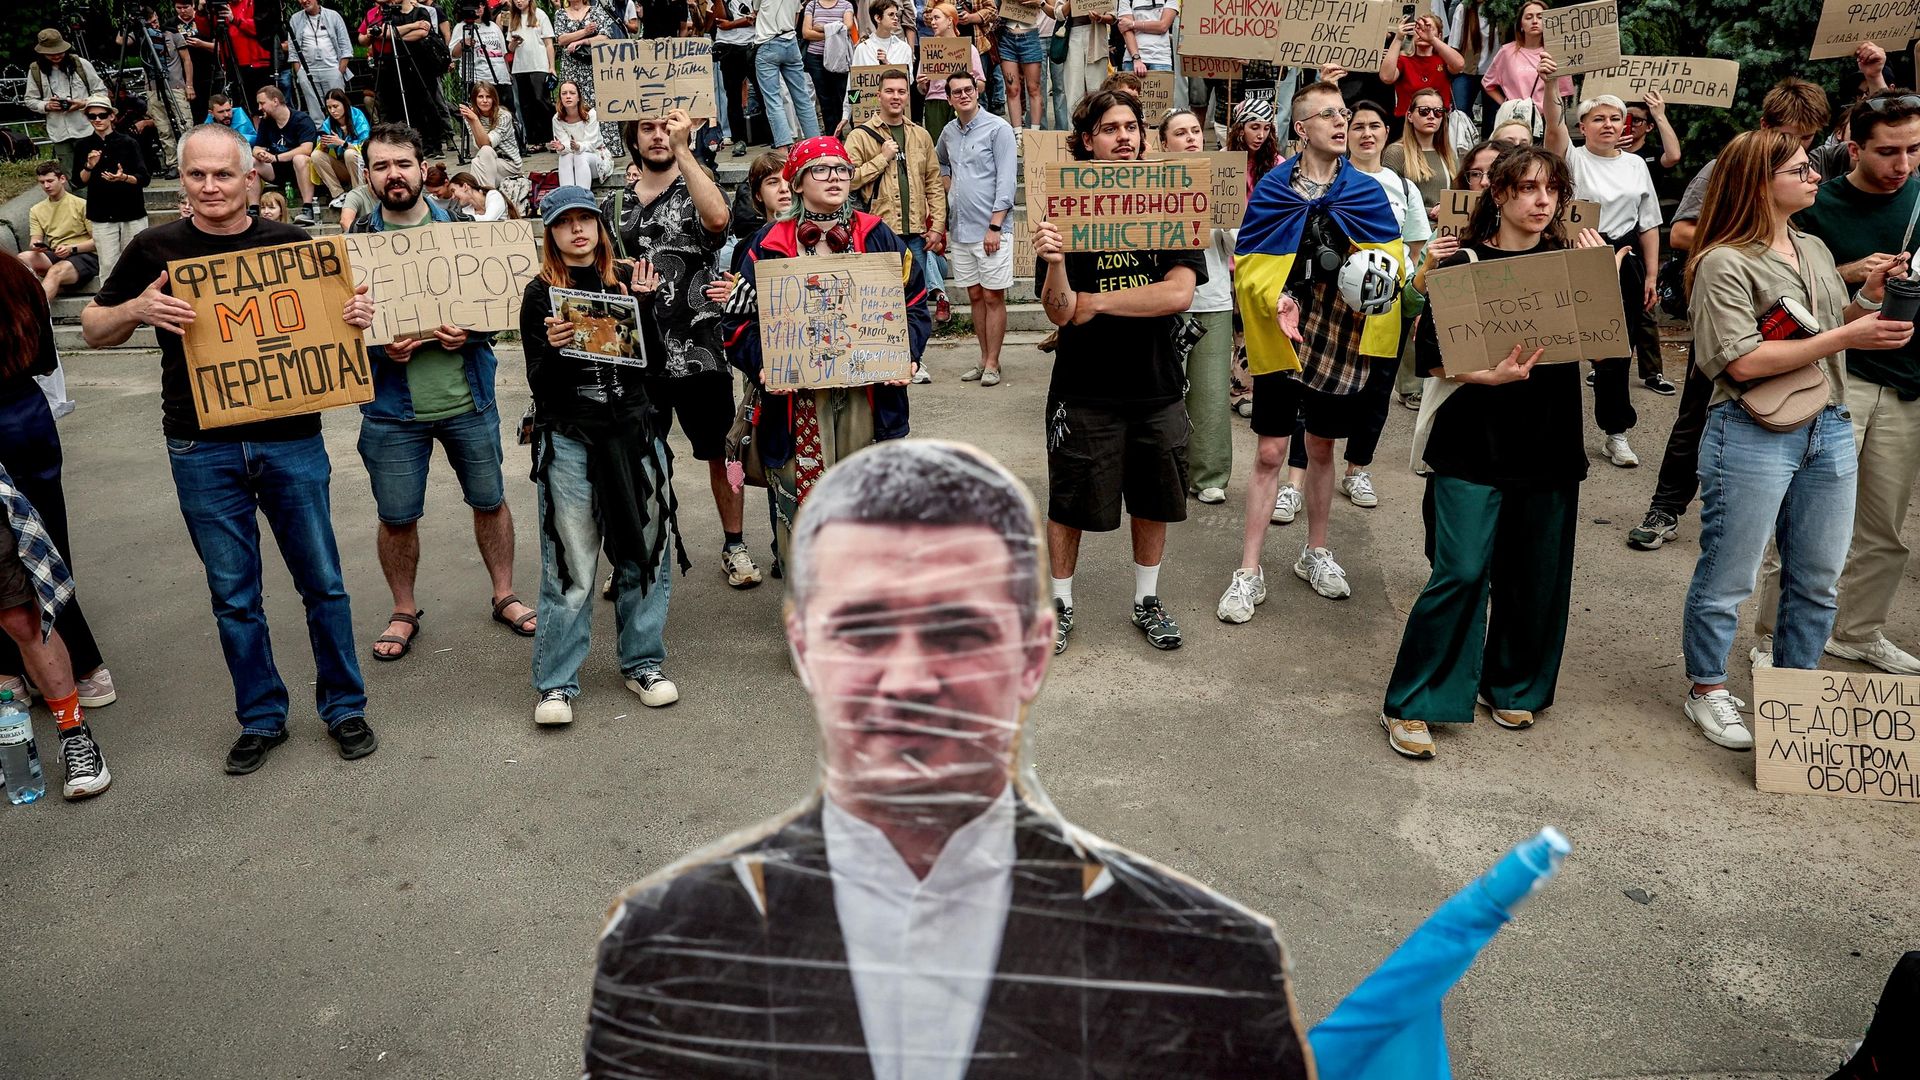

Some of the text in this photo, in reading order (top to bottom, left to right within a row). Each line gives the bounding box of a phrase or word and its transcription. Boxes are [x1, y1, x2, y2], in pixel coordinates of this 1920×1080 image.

[1285, 0, 1367, 24] ВЕРТАЙ
[1200, 15, 1280, 38] ВІЙСЬКОВ
[1311, 22, 1354, 43] ВЖЕ
[1826, 32, 1859, 44] СЛАВА
[1563, 31, 1591, 51] МО
[926, 49, 943, 60] НАС
[1182, 57, 1241, 73] FEDOROV
[1280, 42, 1378, 70] ФЕДОРОВА
[633, 65, 659, 80] ЧАС
[922, 62, 968, 73] НЕДОЧУЛИ
[1630, 78, 1728, 97] ФЕДОРОВА
[1047, 192, 1207, 217] ЕФЕКТИВНОГО
[451, 226, 482, 249] НЕ
[490, 221, 534, 247] ЛОХ
[174, 240, 341, 298] ФЕДОРОВ
[214, 289, 305, 342] МО
[1448, 320, 1538, 343] ГЛУХИХ
[1524, 319, 1621, 349] ПОВЕЗЛО?
[196, 338, 369, 413] ПЕРЕМОГА!
[1759, 700, 1916, 741] ФЕДОРОВ
